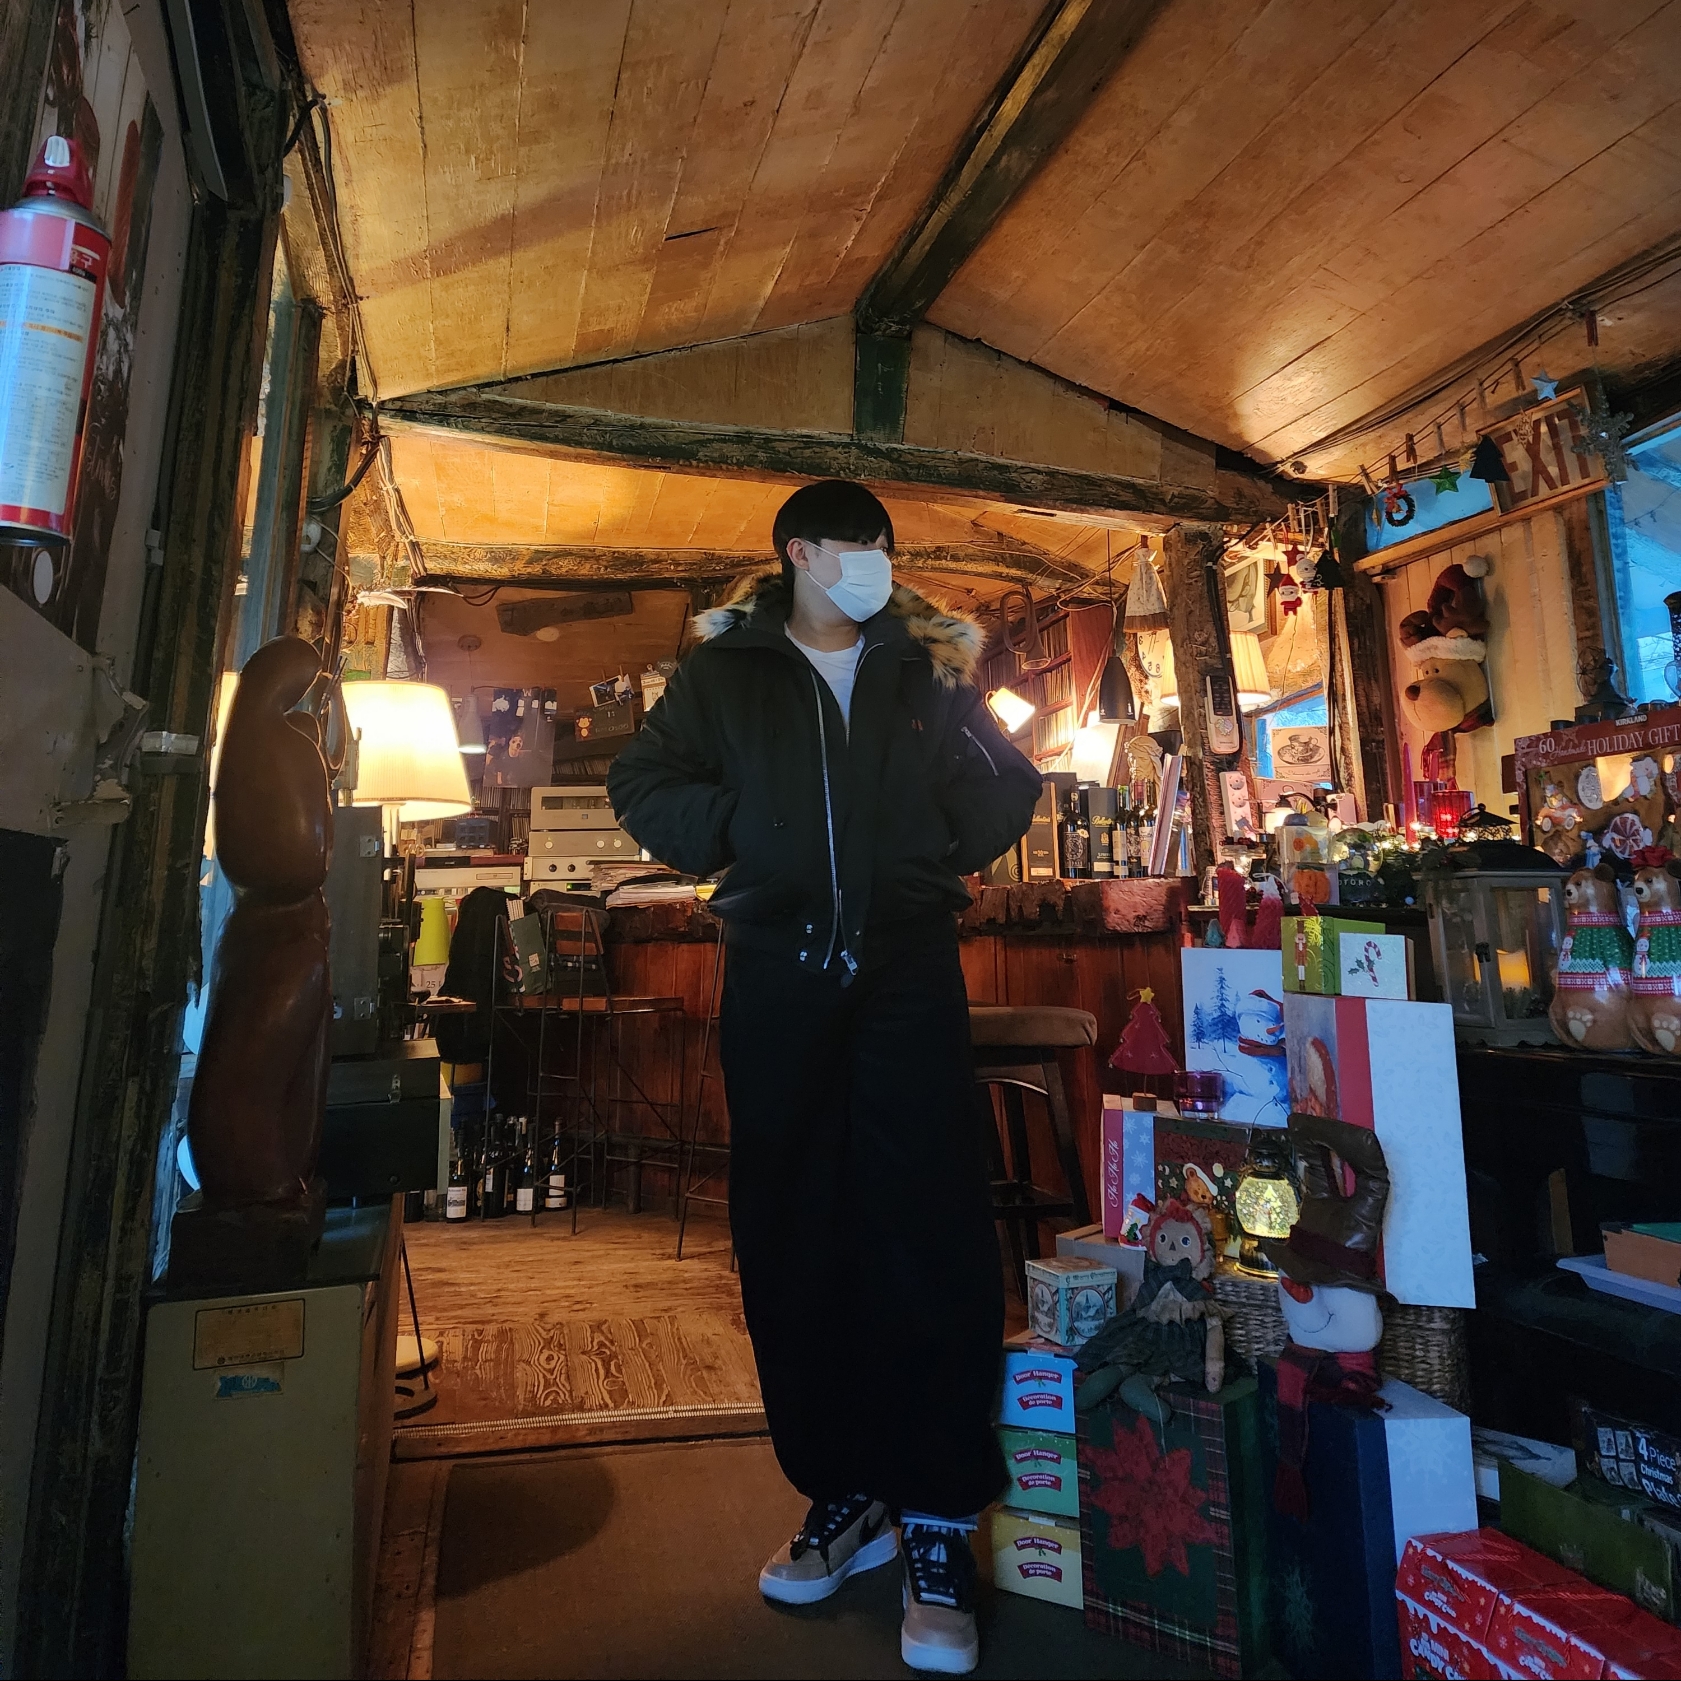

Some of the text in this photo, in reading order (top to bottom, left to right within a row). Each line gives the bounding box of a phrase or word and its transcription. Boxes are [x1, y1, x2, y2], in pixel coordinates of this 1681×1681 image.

[1494, 407, 1592, 505] EXIT
[1615, 714, 1648, 727] KIRKLAND
[1538, 737, 1555, 754] 60
[1587, 730, 1646, 756] HOLIDAY
[1648, 723, 1681, 745] GIFT
[1015, 1370, 1060, 1381] Door Hanger
[1015, 1449, 1058, 1459] Door Hanger
[1638, 1437, 1676, 1472] 4 Piece
[1641, 1463, 1673, 1485] Christmas
[1033, 1537, 1059, 1548] Hanger
